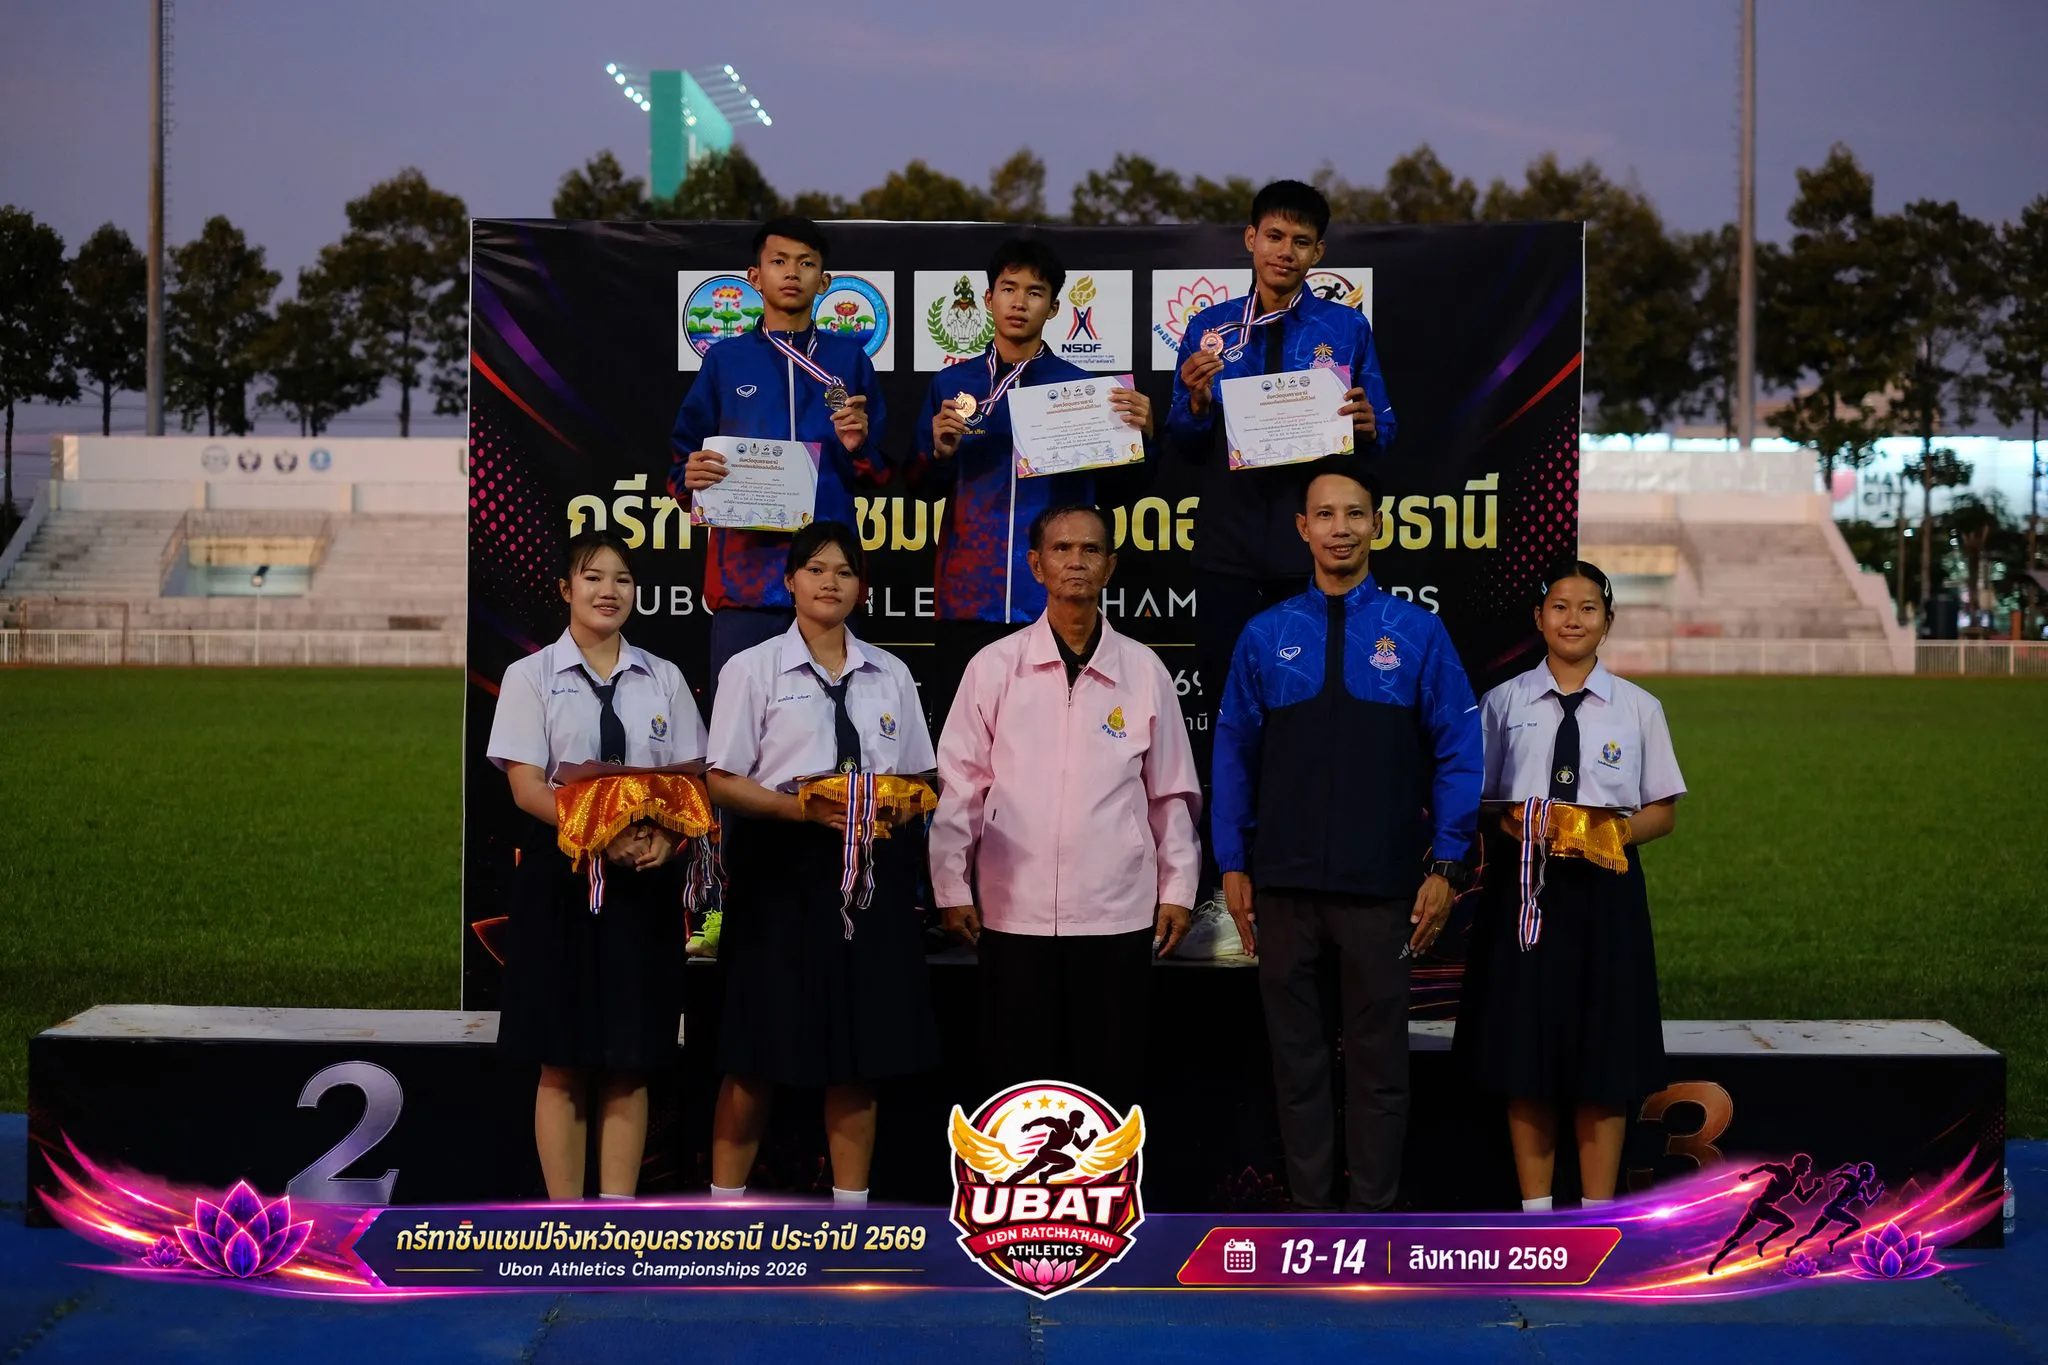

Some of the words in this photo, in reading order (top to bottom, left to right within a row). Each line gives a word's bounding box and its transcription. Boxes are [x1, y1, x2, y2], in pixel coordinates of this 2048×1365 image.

[1061, 343, 1102, 353] NSDF
[636, 585, 714, 616] UB
[285, 1060, 404, 1205] 2
